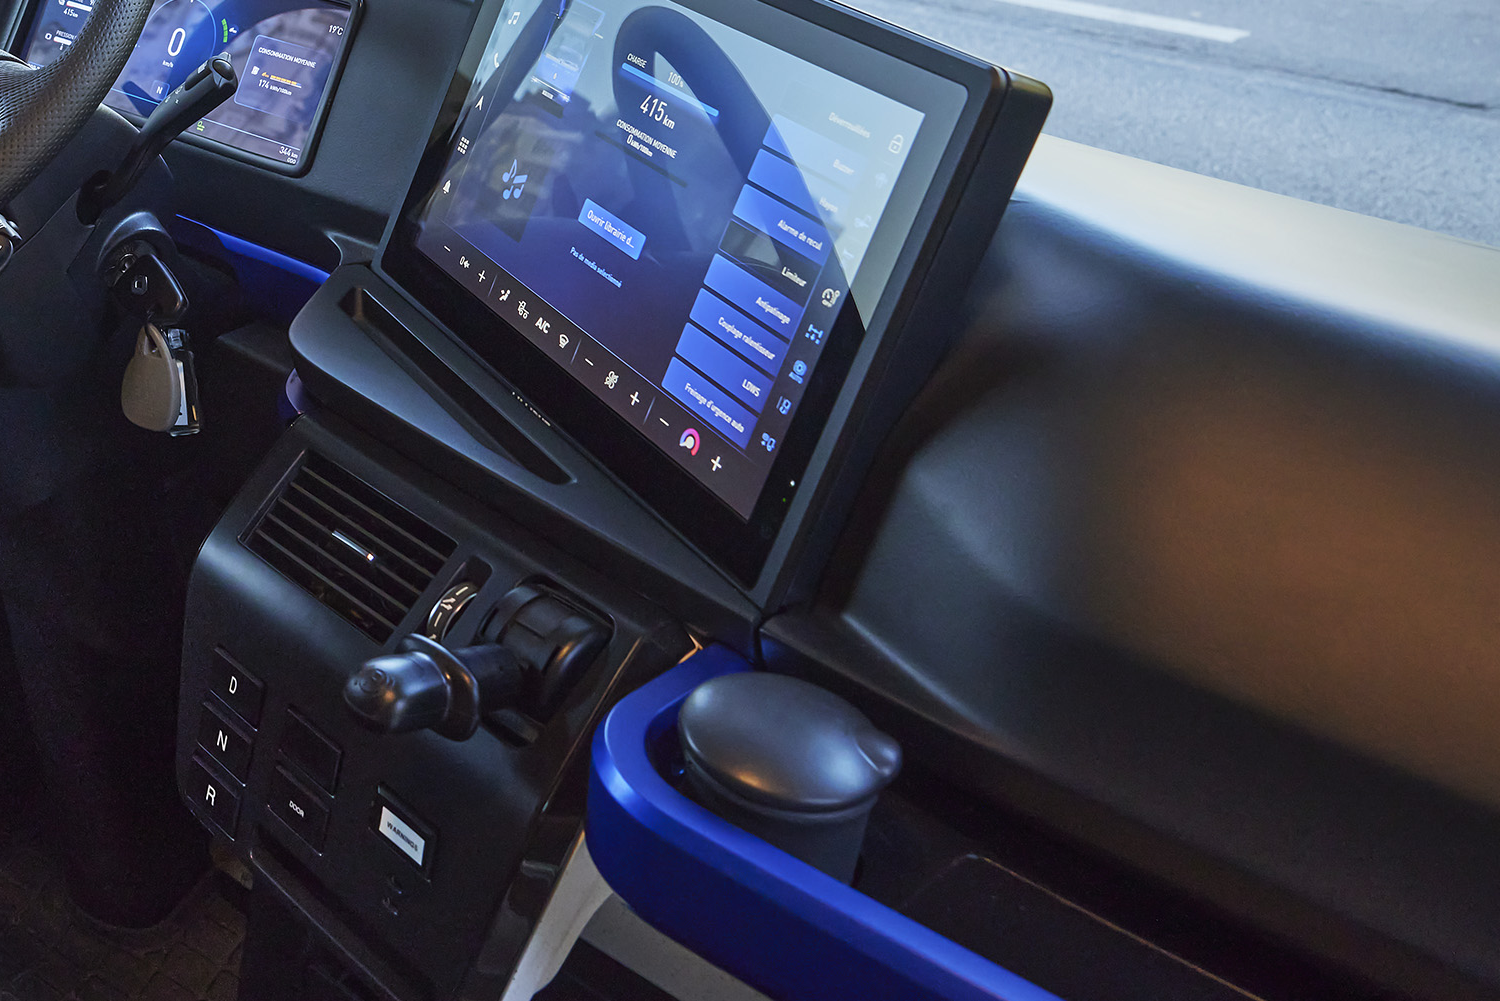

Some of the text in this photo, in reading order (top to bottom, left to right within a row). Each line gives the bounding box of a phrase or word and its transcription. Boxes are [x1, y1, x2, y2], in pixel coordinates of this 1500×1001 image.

[167, 27, 186, 57] 0
[162, 60, 174, 68] km/h
[258, 47, 317, 69] CONSOMMATION MOYENNE
[627, 53, 647, 69] CHARGE
[156, 85, 163, 95] N
[258, 79, 270, 90] 174
[639, 94, 676, 130] 415 km
[616, 118, 678, 159] CONSOMMATION MOYENNE
[626, 134, 634, 145] 0
[279, 146, 291, 157] 344
[587, 209, 605, 227] Ouvrir
[603, 220, 627, 242] librairie
[777, 219, 823, 251] Alarme de recul
[569, 246, 579, 258] Pas
[781, 266, 807, 287] Limiteur
[755, 296, 791, 325] Antipatinage
[535, 316, 551, 334] A/C
[718, 316, 776, 360] Couplage ralentisseur
[684, 382, 708, 405] Freinage
[730, 420, 745, 434] auto
[228, 675, 238, 695] D
[216, 729, 228, 752] N
[205, 784, 217, 806] R
[288, 800, 305, 818] DOOR
[386, 820, 420, 853] WARNINGS
